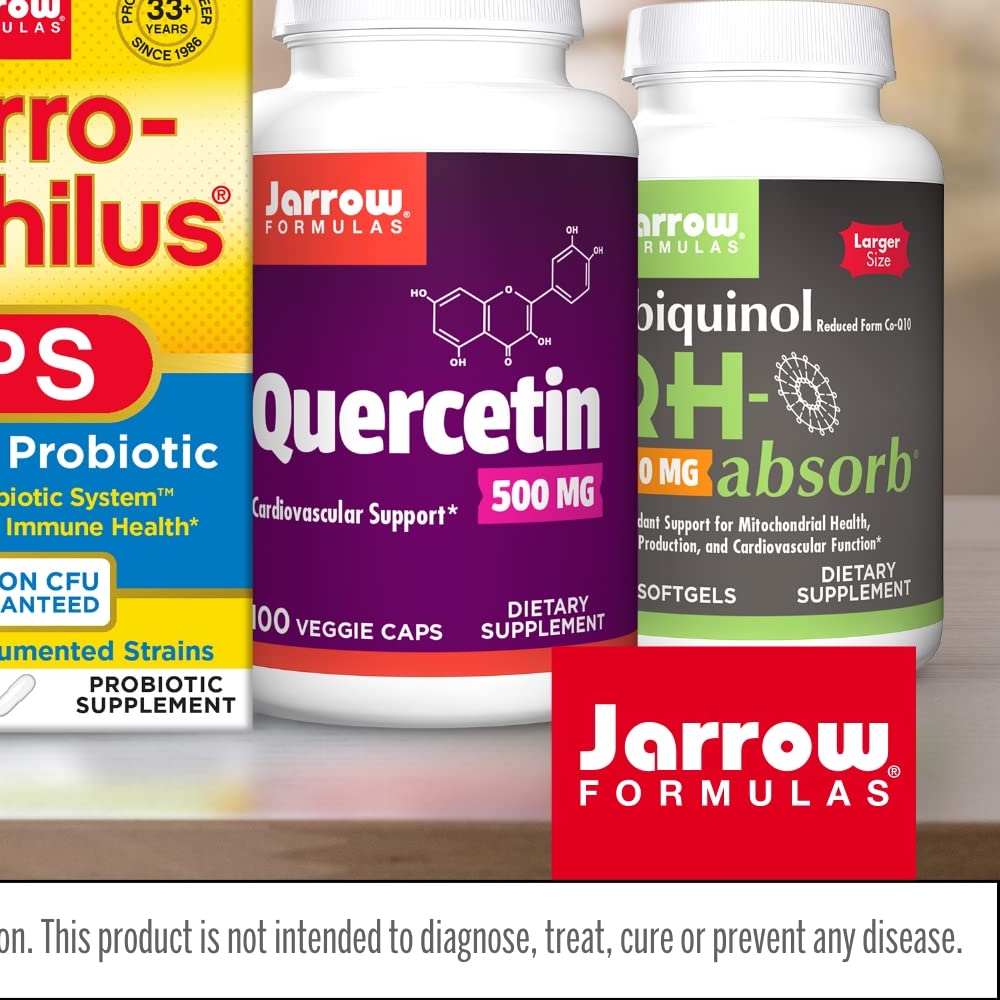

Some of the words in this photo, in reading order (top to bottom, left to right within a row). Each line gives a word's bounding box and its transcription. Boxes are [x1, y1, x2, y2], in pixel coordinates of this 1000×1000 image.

[146, 24, 188, 34] YEARS
[132, 37, 171, 60] SINCE
[175, 37, 202, 60] 1986
[265, 220, 403, 234] FORMULAS
[854, 233, 900, 253] Larger
[866, 251, 891, 267] Size
[816, 318, 858, 332] Reduced
[860, 318, 883, 332] Form
[884, 317, 912, 332] Co-Q10
[253, 366, 600, 464] Quercetin
[9, 434, 218, 469] Probiotic
[659, 458, 699, 487] MG
[491, 478, 550, 511] 500
[557, 475, 594, 509] MG
[252, 496, 364, 525] Cardiovascular
[7, 518, 103, 537] Immune
[664, 515, 710, 535] Support
[714, 515, 734, 532] for
[738, 514, 827, 533] Mitochondrial
[830, 513, 871, 532] Health,
[638, 535, 702, 556] Production,
[705, 537, 728, 555] and
[732, 537, 827, 555] Cardiovascular
[46, 572, 99, 591] CFU
[822, 562, 897, 583] DIETARY
[638, 583, 737, 604] SOFTGELS
[797, 579, 912, 604] SUPPLEMENT
[508, 596, 588, 618] DIETARY
[295, 619, 374, 640] VEGGIE
[381, 623, 443, 641] CAPS
[481, 613, 605, 640] SUPPLEMENT
[124, 640, 214, 661] Strains
[90, 675, 223, 693] PROBIOTIC
[76, 696, 236, 714] SUPPLEMENT
